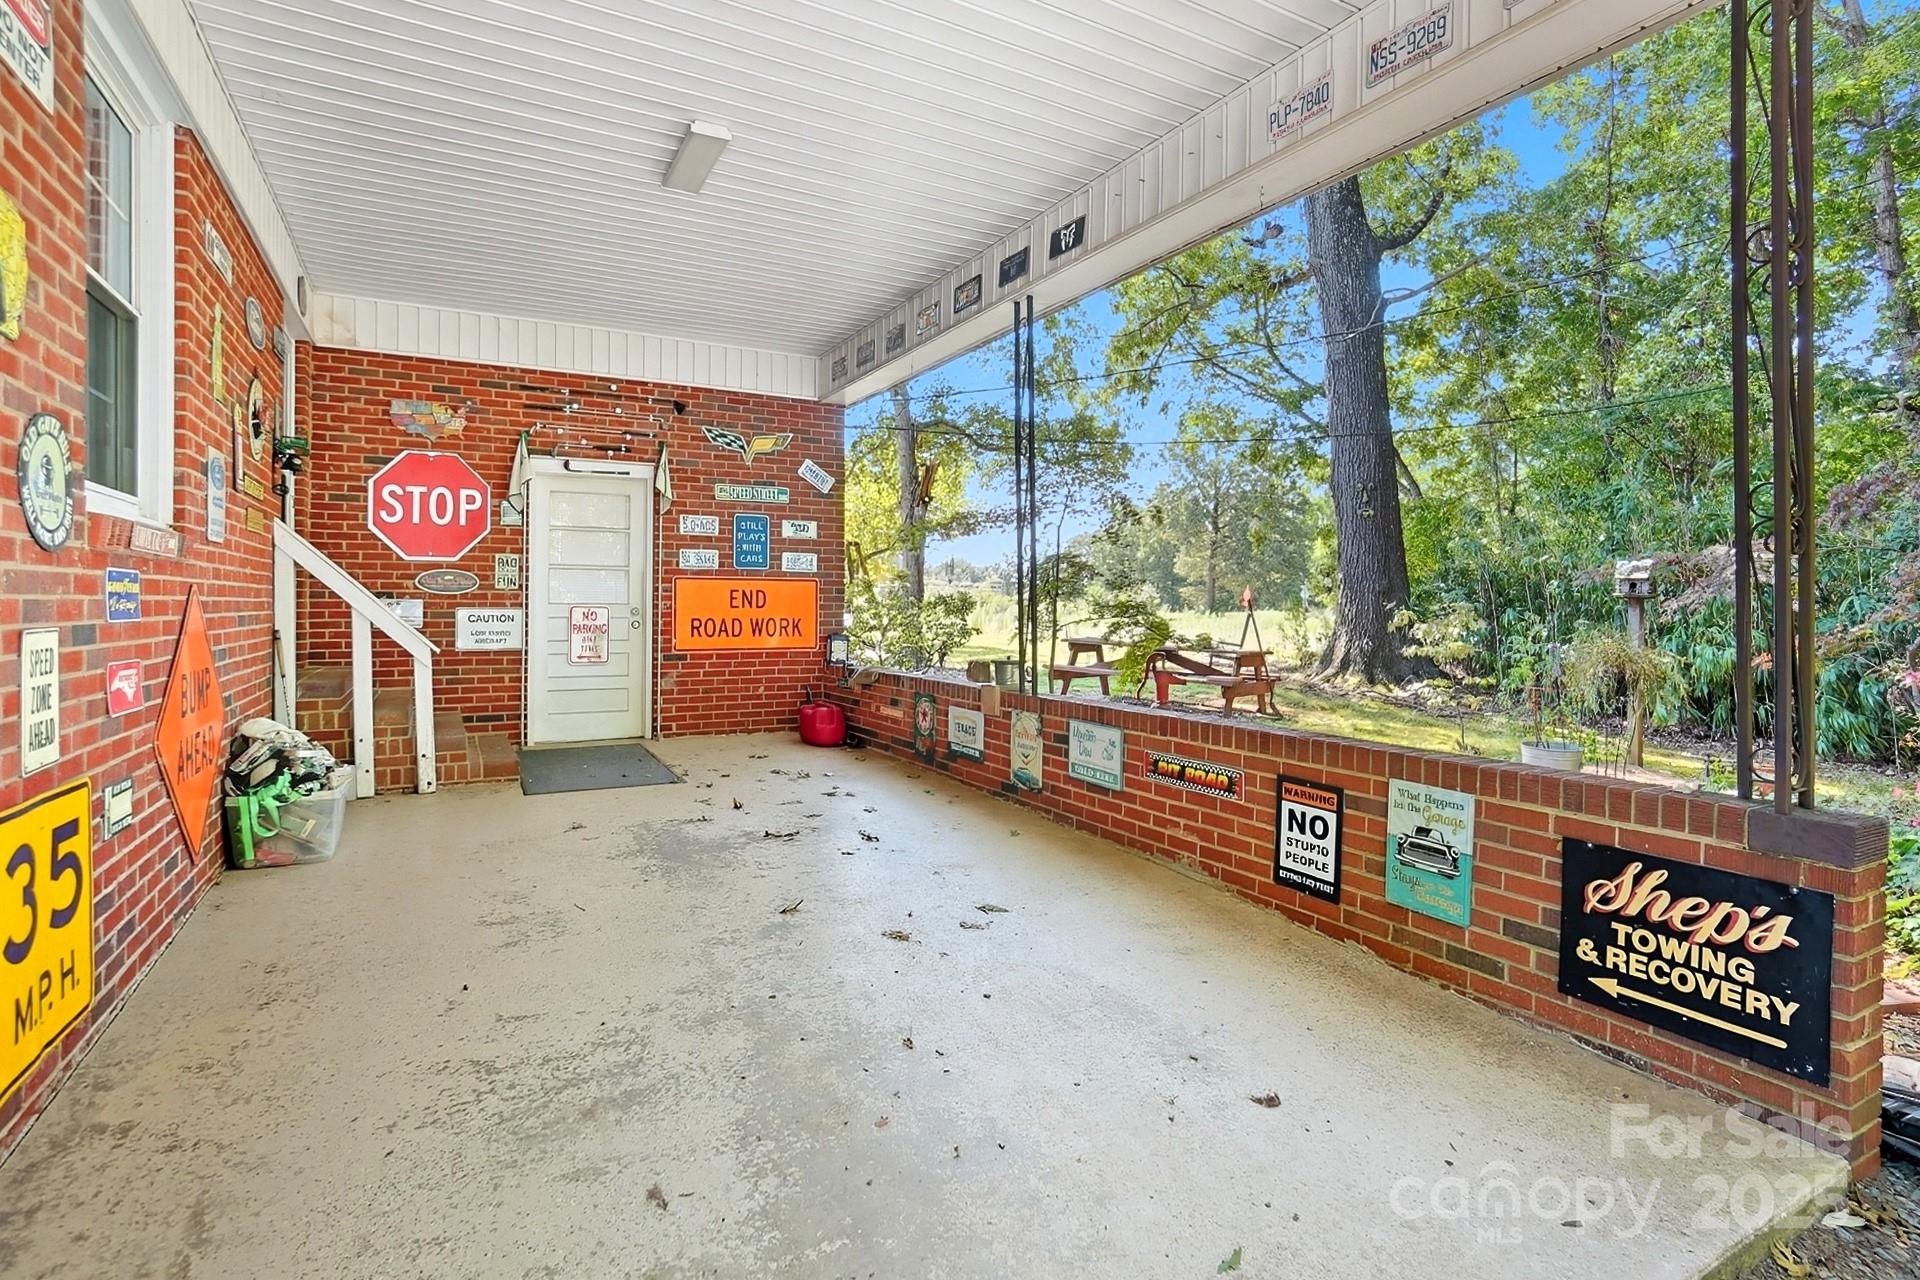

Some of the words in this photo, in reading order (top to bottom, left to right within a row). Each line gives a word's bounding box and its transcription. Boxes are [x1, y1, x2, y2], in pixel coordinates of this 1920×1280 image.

[18, 29, 44, 72] NOT
[1370, 15, 1446, 75] NSS-9289
[1270, 82, 1329, 133] PLP-7840
[378, 484, 483, 526] STOP
[737, 532, 766, 541] PLAYS
[740, 521, 763, 530] STILL
[740, 554, 763, 562] CARS
[729, 589, 767, 609] END
[467, 614, 514, 623] CAUTION
[572, 623, 607, 635] PARKING
[582, 610, 597, 622] NO
[690, 618, 743, 638] ROAD
[749, 617, 803, 638] WORK
[30, 647, 55, 678] SPEED
[31, 683, 53, 715] ZONE
[181, 667, 211, 719] BUMP
[29, 718, 56, 752] AHEAD
[177, 725, 215, 786] AHEAD
[1283, 786, 1335, 807] WARNING
[1397, 788, 1420, 804] What
[1424, 793, 1464, 811] Happens
[1287, 808, 1329, 840] NO
[1422, 806, 1466, 836] Garage
[1285, 850, 1329, 874] PEOPLE
[1286, 836, 1329, 857] STUPID
[4, 817, 83, 965] 35
[1583, 861, 1799, 954] Shep's
[1611, 921, 1756, 985] TOWING
[1575, 938, 1602, 966] &
[1605, 944, 1800, 1027] RECOVERY
